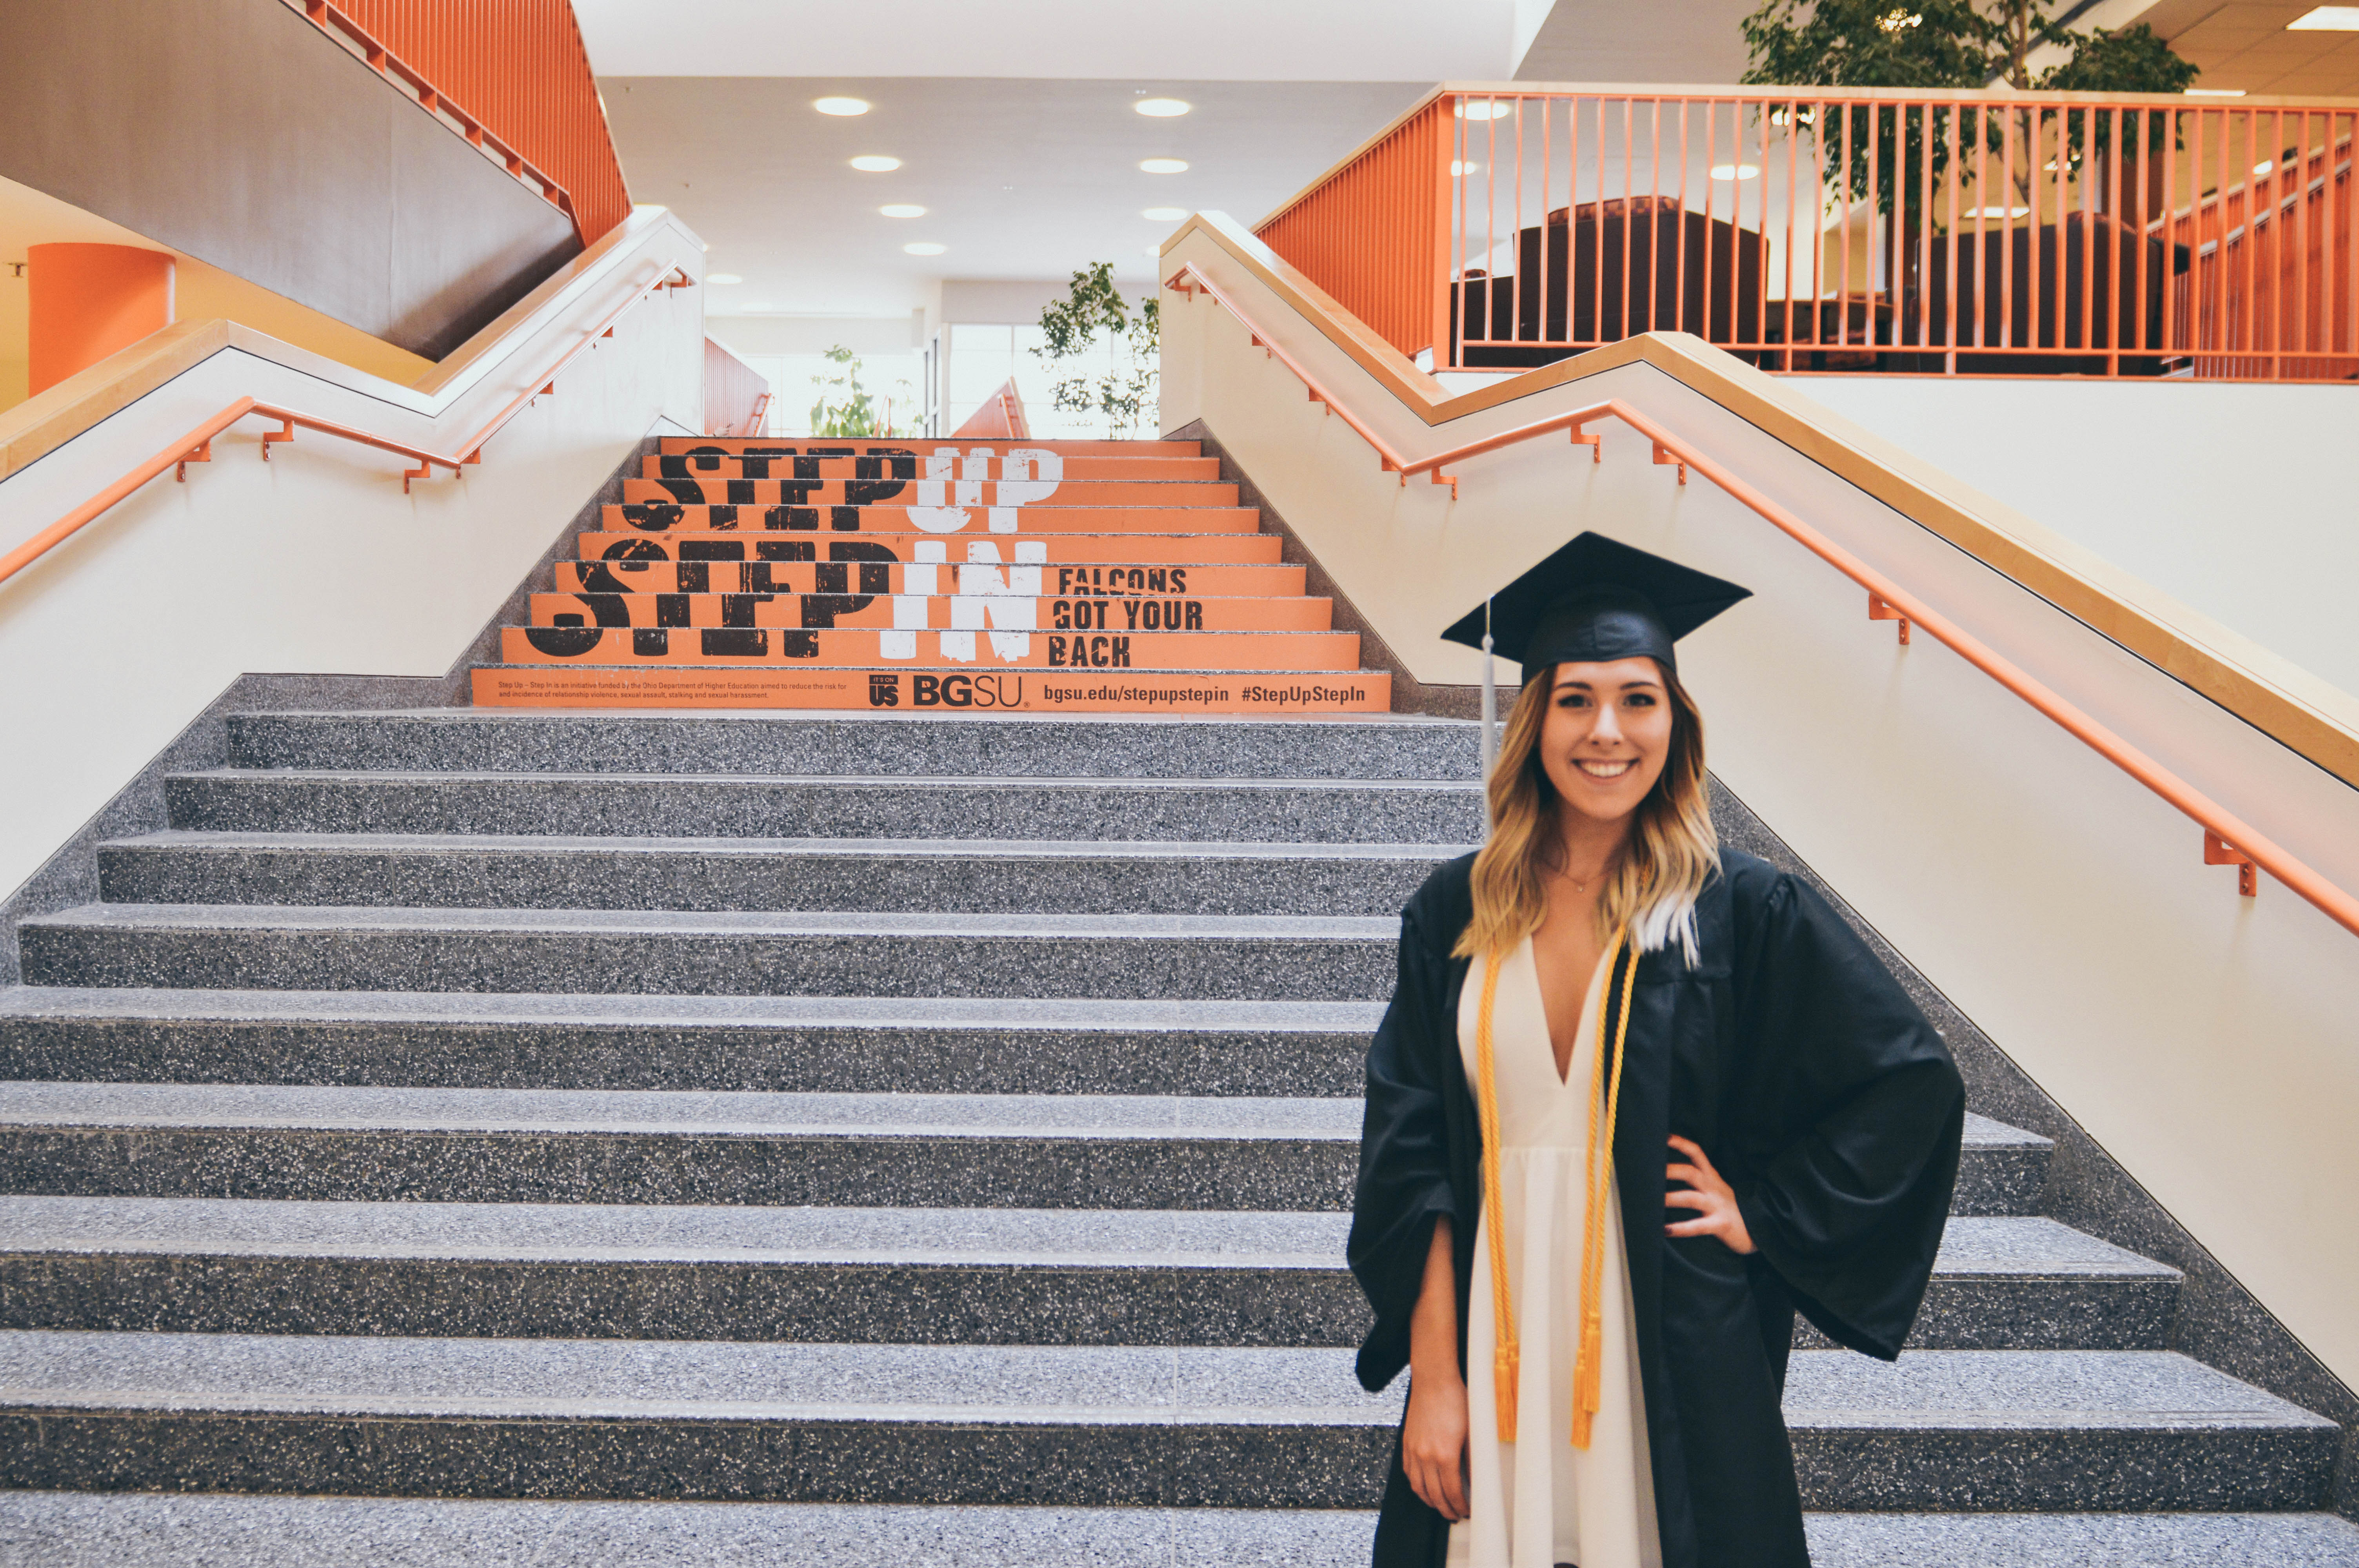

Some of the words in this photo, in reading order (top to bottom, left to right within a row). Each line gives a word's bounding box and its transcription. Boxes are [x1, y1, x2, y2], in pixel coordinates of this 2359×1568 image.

[622, 446, 916, 531] STEP
[906, 447, 1063, 534] UP
[1058, 568, 1187, 595] FALCONS
[525, 539, 899, 657] STEP
[880, 541, 1047, 663] IN
[1054, 600, 1107, 630] GOT
[1123, 600, 1203, 630] YOUR
[1048, 636, 1131, 668] BACK
[869, 685, 899, 706] US
[1044, 685, 1229, 704] bgsu.edu/stepupstepin
[1241, 686, 1365, 704] #StepUpStepIn
